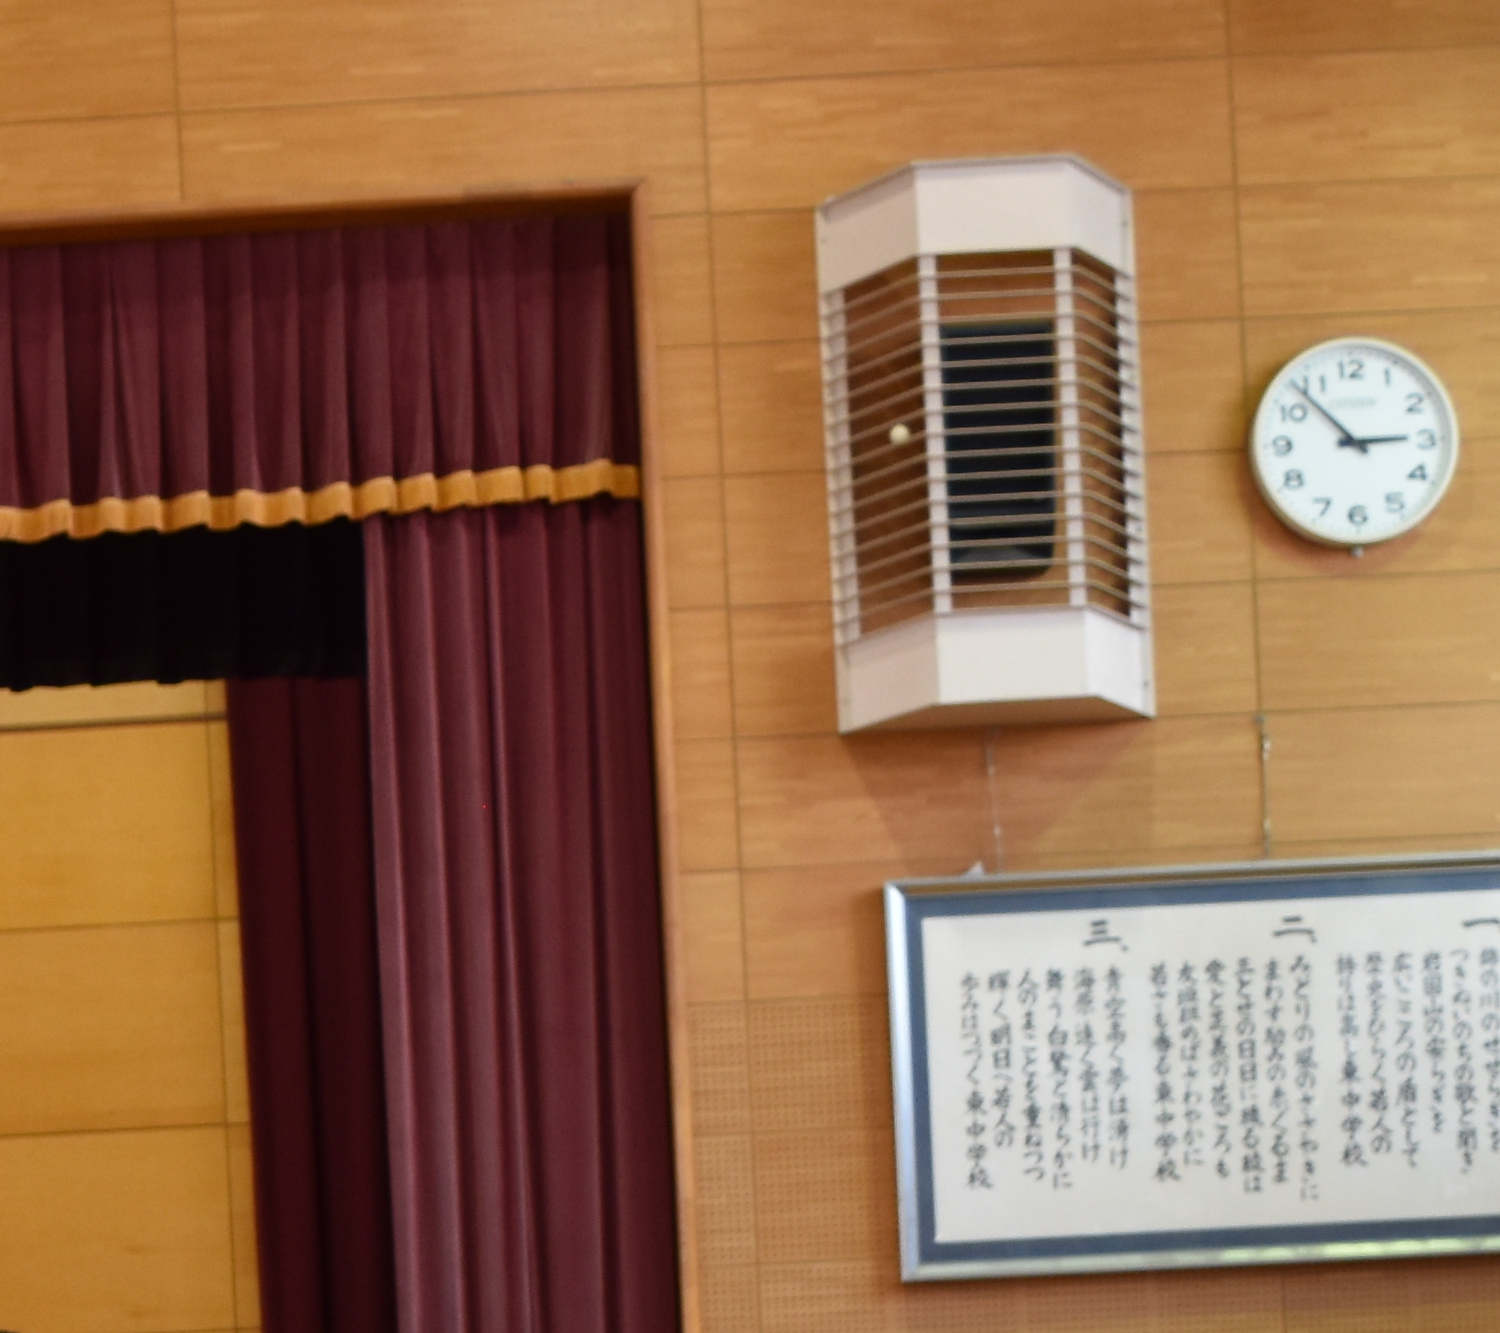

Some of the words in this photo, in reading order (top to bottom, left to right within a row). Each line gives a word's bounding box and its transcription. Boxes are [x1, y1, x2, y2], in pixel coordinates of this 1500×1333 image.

[1338, 359, 1364, 380] 12
[1384, 368, 1391, 386] 1
[1405, 392, 1424, 413] 2
[1280, 403, 1308, 423] 10
[1272, 435, 1293, 457] 9
[1417, 428, 1437, 450] 3
[1284, 469, 1304, 489] 8
[1408, 463, 1428, 482] 4
[1312, 498, 1332, 517] 7
[1384, 492, 1405, 513] 5
[1348, 505, 1368, 525] 6
